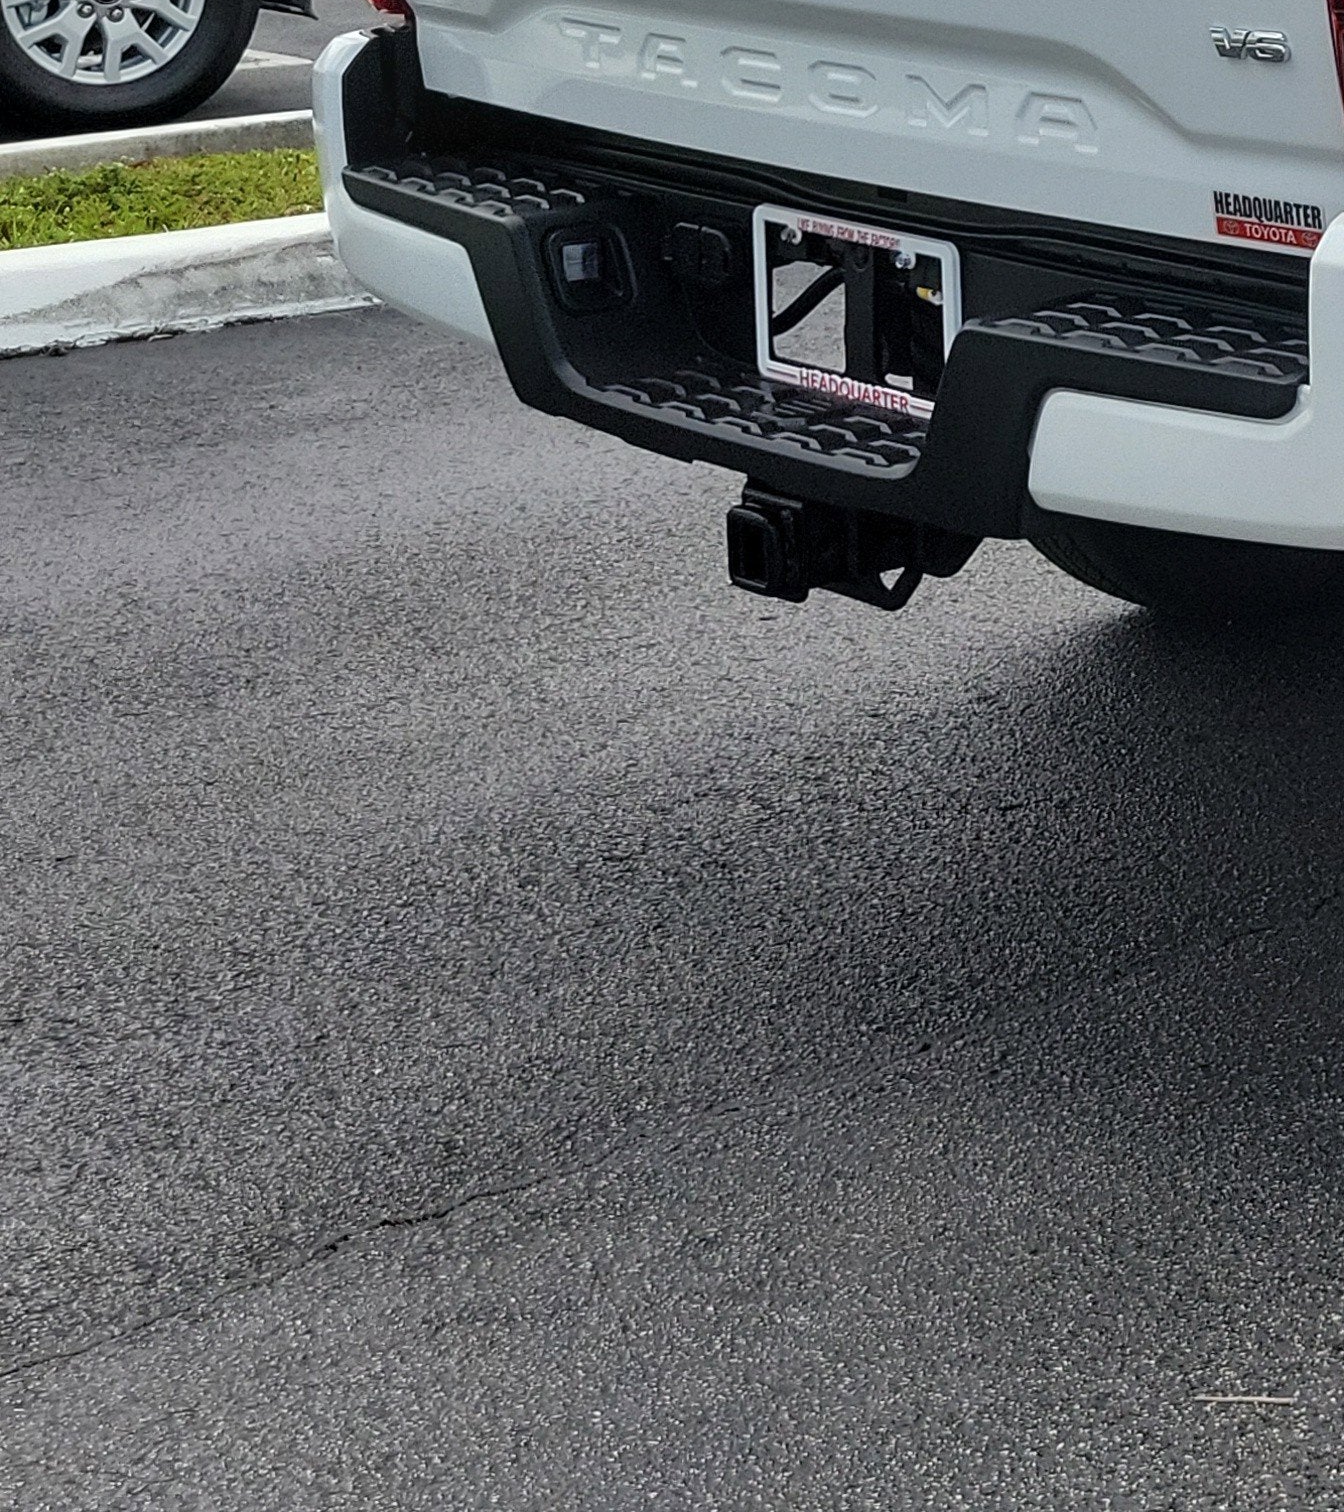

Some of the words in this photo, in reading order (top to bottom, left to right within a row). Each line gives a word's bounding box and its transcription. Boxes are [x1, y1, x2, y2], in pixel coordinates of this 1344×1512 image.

[1209, 26, 1291, 64] V6
[561, 16, 1100, 154] TACOMA
[1213, 190, 1323, 230] HEADQUARTER
[1244, 223, 1297, 246] TOYOTA
[799, 371, 911, 413] HEADQUARTER
